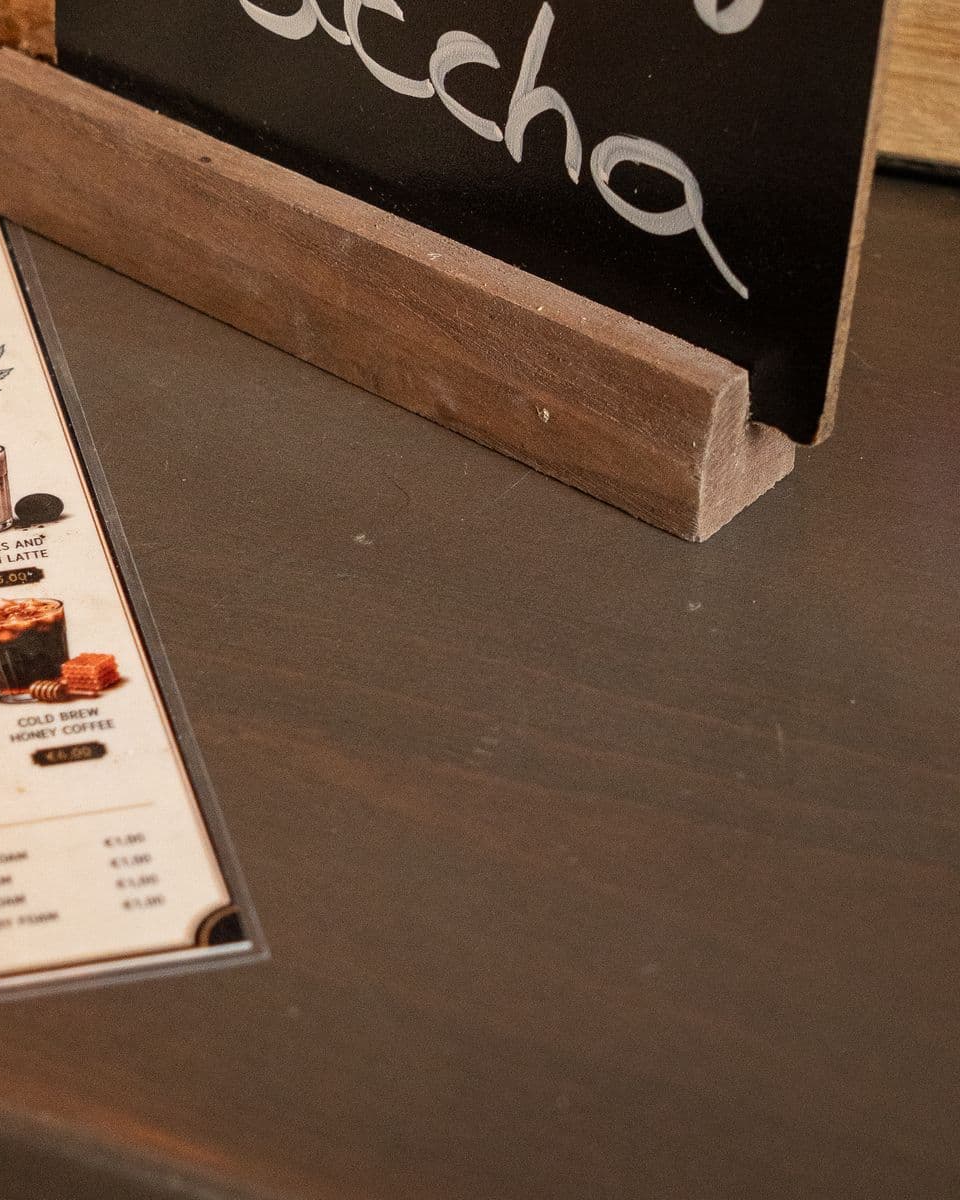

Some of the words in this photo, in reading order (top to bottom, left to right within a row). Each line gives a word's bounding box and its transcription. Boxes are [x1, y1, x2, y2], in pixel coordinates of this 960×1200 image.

[15, 537, 44, 549] AND
[7, 549, 49, 563] LATTE
[17, 713, 55, 728] COLD
[59, 707, 99, 722] BREW
[9, 727, 57, 742] HONEY
[62, 719, 115, 736] COFFEE
